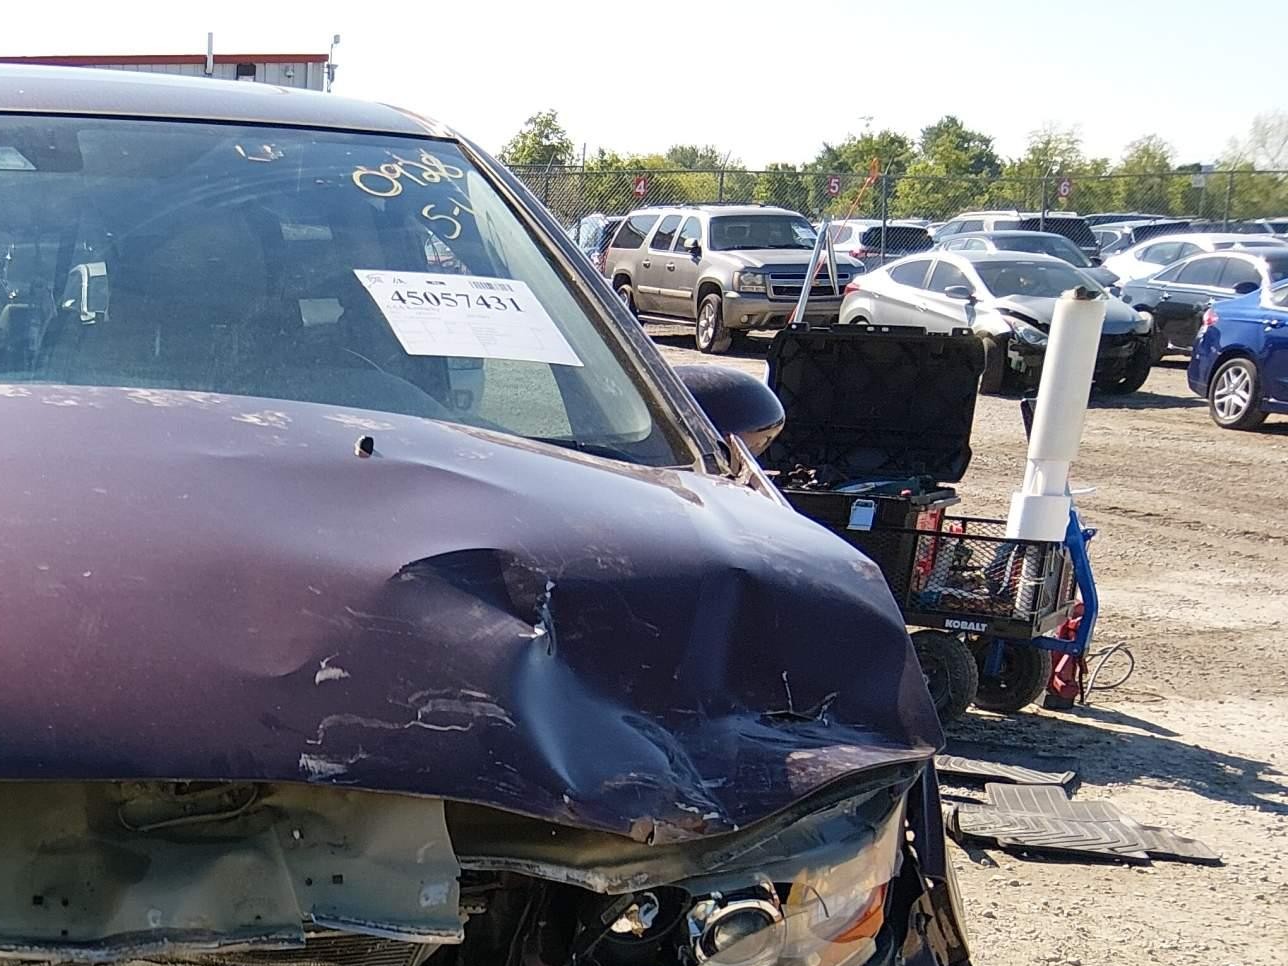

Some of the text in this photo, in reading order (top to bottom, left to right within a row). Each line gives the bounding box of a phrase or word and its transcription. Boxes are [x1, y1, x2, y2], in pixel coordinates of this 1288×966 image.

[636, 180, 645, 195] 4
[830, 178, 839, 193] 5
[1060, 181, 1070, 195] 6
[391, 289, 525, 313] 45057431
[944, 618, 988, 632] KOBALT
